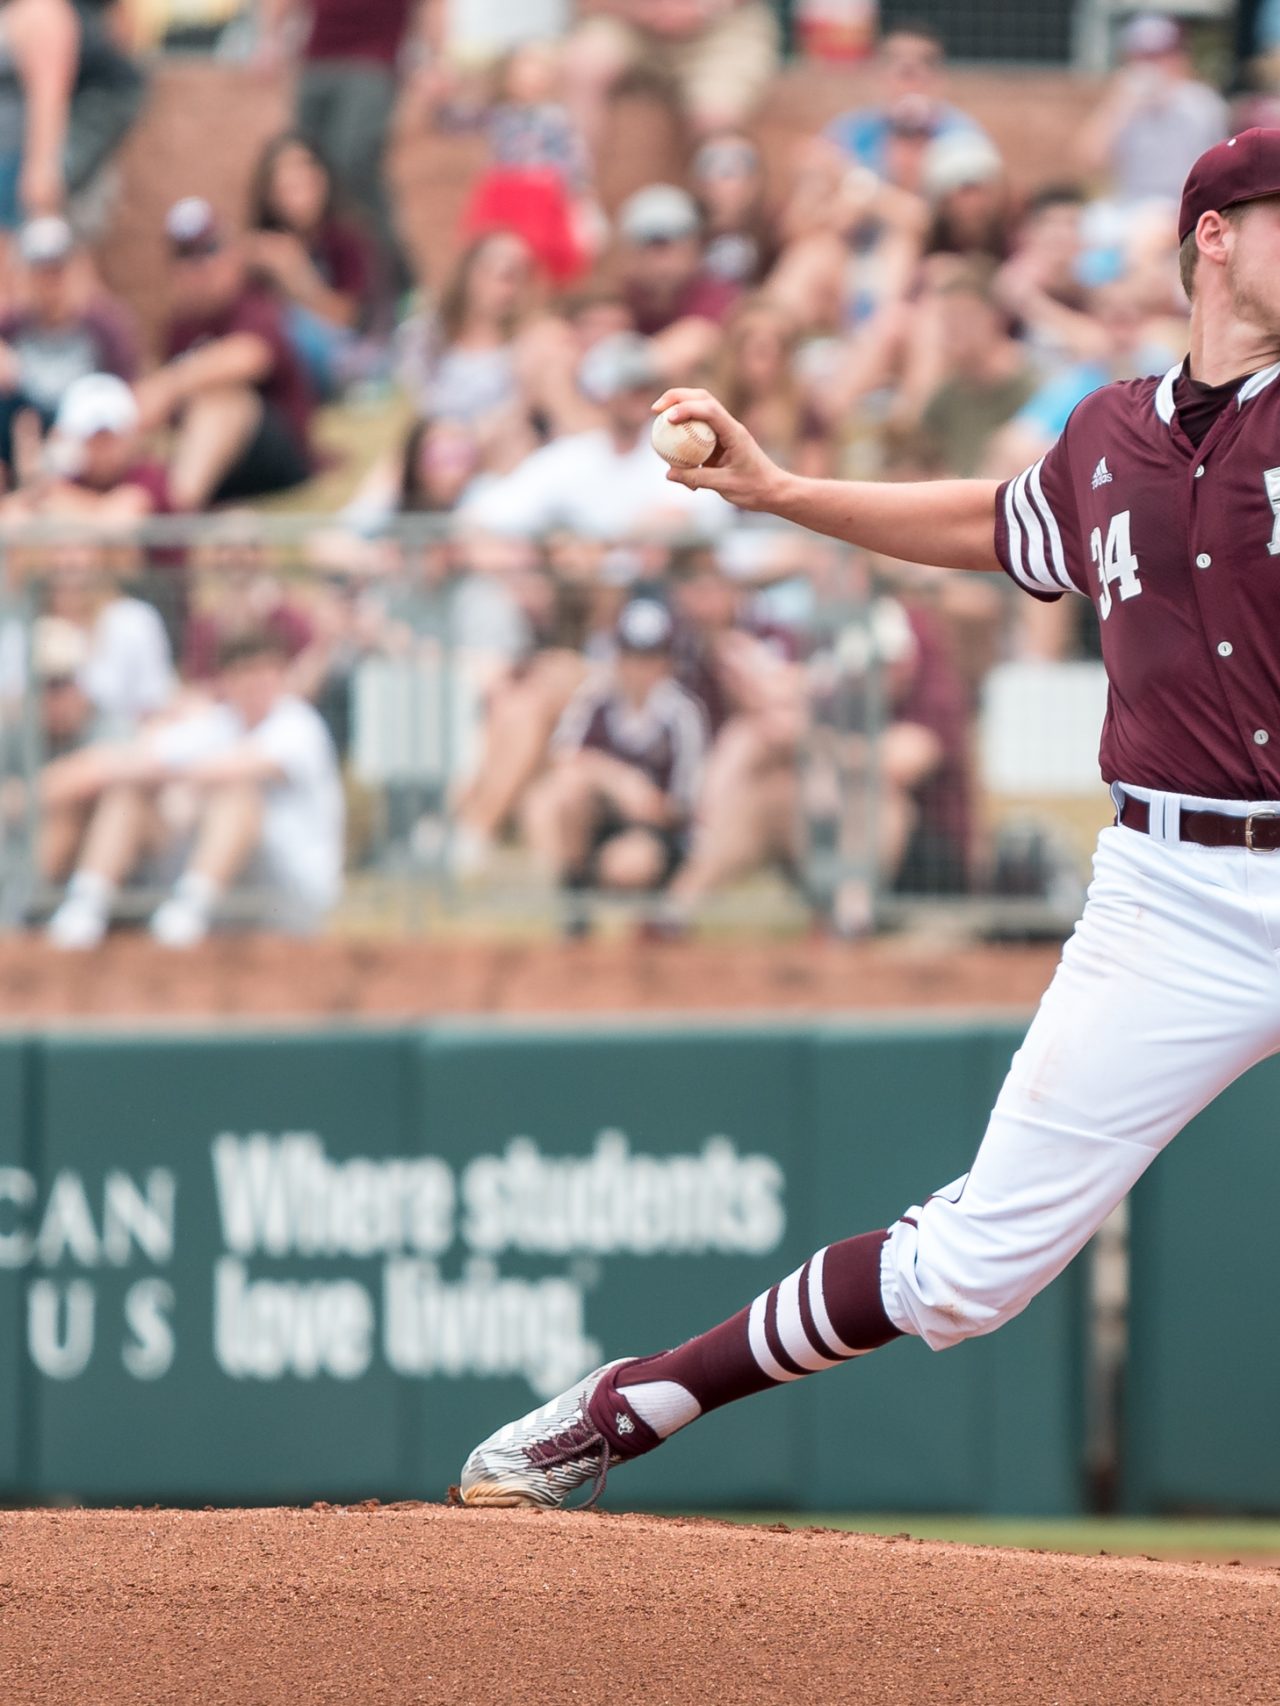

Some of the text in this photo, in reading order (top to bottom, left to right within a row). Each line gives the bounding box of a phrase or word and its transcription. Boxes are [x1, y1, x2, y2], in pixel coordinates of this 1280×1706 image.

[1091, 510, 1142, 621] 34
[213, 1130, 784, 1256] Where students
[213, 1255, 374, 1380] love
